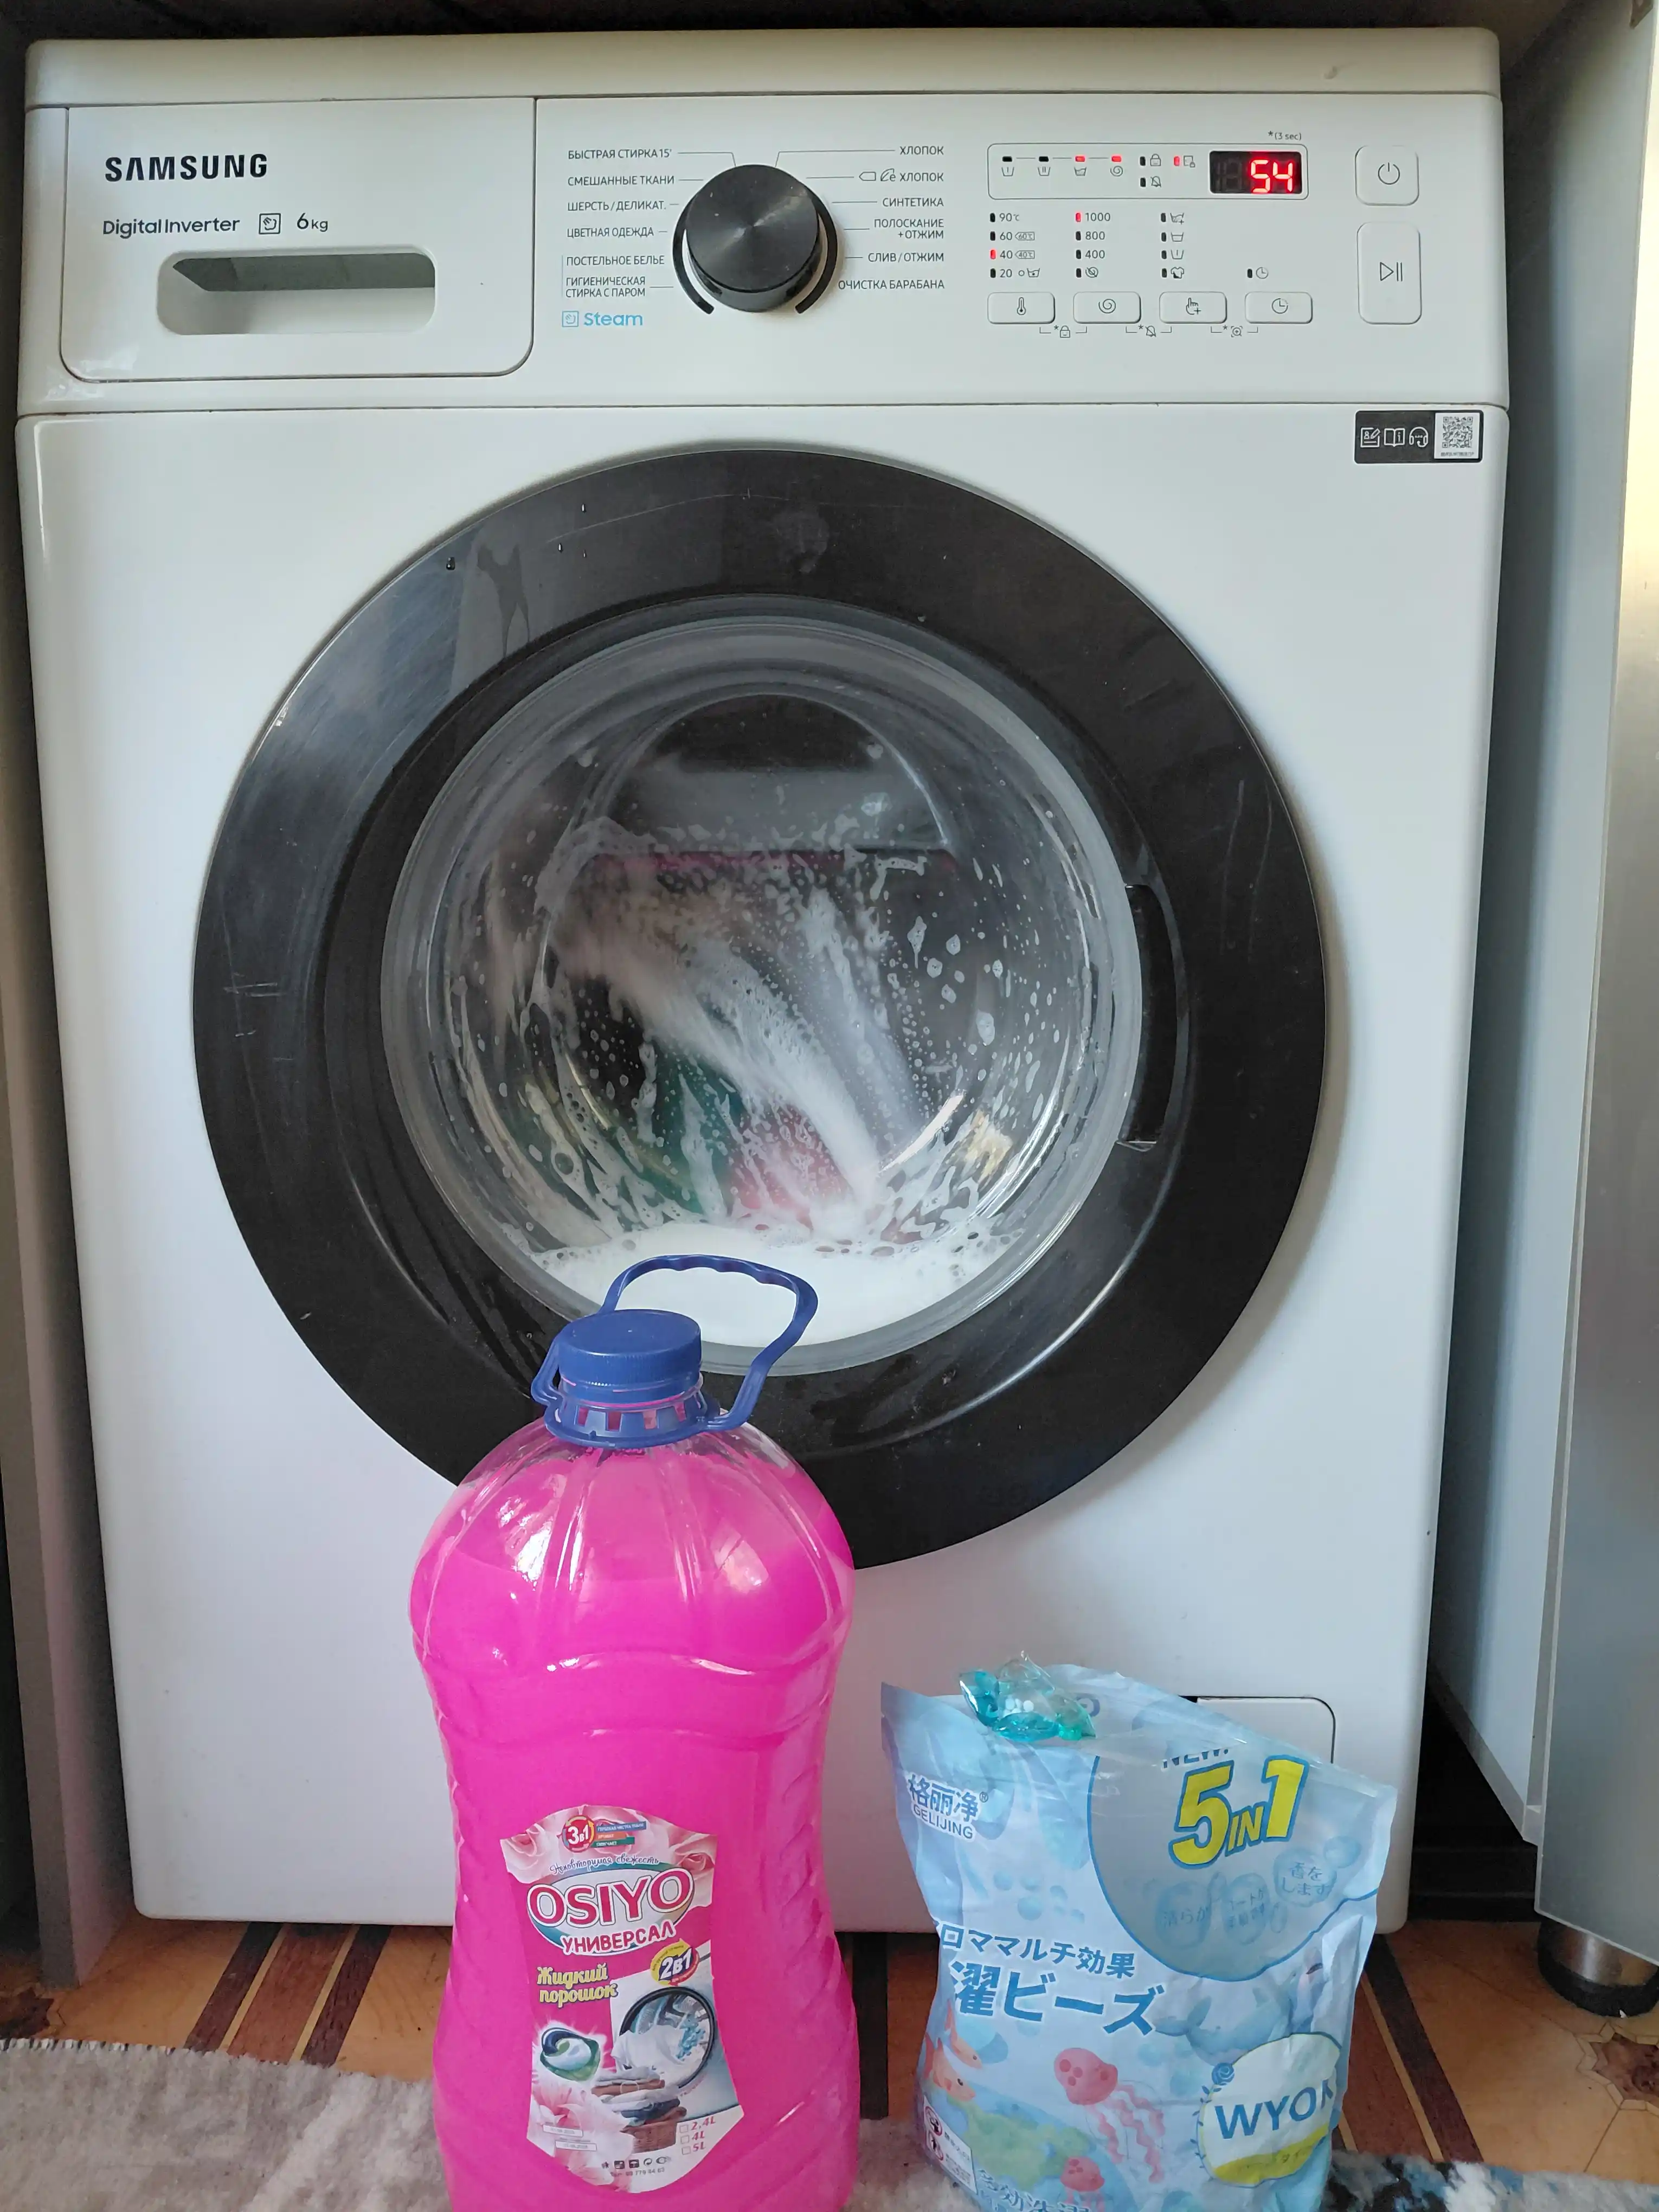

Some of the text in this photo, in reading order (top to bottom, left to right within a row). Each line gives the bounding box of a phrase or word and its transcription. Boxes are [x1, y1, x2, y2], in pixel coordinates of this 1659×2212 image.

[1285, 132, 1302, 141] sec)
[568, 149, 615, 159] БЫСТРАЯ
[618, 149, 658, 158] СТИРКА
[899, 146, 944, 155] ХЛОПОК
[105, 153, 267, 182] SAMSUNG
[568, 175, 674, 186] СМЕШАННЫЕ ТКАНИ
[899, 172, 944, 182] ХЛОПОК
[1251, 159, 1293, 194] 54
[882, 197, 944, 207] СИНТЕТИКА
[1085, 213, 1111, 221] 1000
[874, 218, 944, 228] ПОЛОСКАНИЕ
[567, 227, 654, 239] ЦВЕТНАЯ ОДЕЖДА
[1000, 232, 1012, 240] 60
[1085, 231, 1105, 240] 800
[1000, 250, 1013, 259] 40
[1085, 249, 1105, 259] 400
[567, 255, 665, 266] ПОСТЕЛЬНОЕ БЕЛЬЕ
[1000, 268, 1012, 278] 20
[566, 276, 646, 286] ГИГИЕНИЧЕСКАЯ
[838, 279, 944, 290] ОЧИСТКА БАРАБАНА
[565, 288, 645, 298] СТИРКА С ПАРОМ
[583, 312, 643, 326] Steam
[914, 1804, 973, 1840] GELIJING
[616, 1853, 659, 1866] свежесть
[528, 1869, 693, 1927] OSIYO
[562, 1922, 674, 1953] УНИВЕРСАЛ
[934, 1921, 1135, 1979] ロママルチ効果
[537, 1963, 608, 1989] Жидкий
[539, 1983, 618, 2008] порошок
[692, 2131, 705, 2140] 4L
[693, 2142, 706, 2152] 5L
